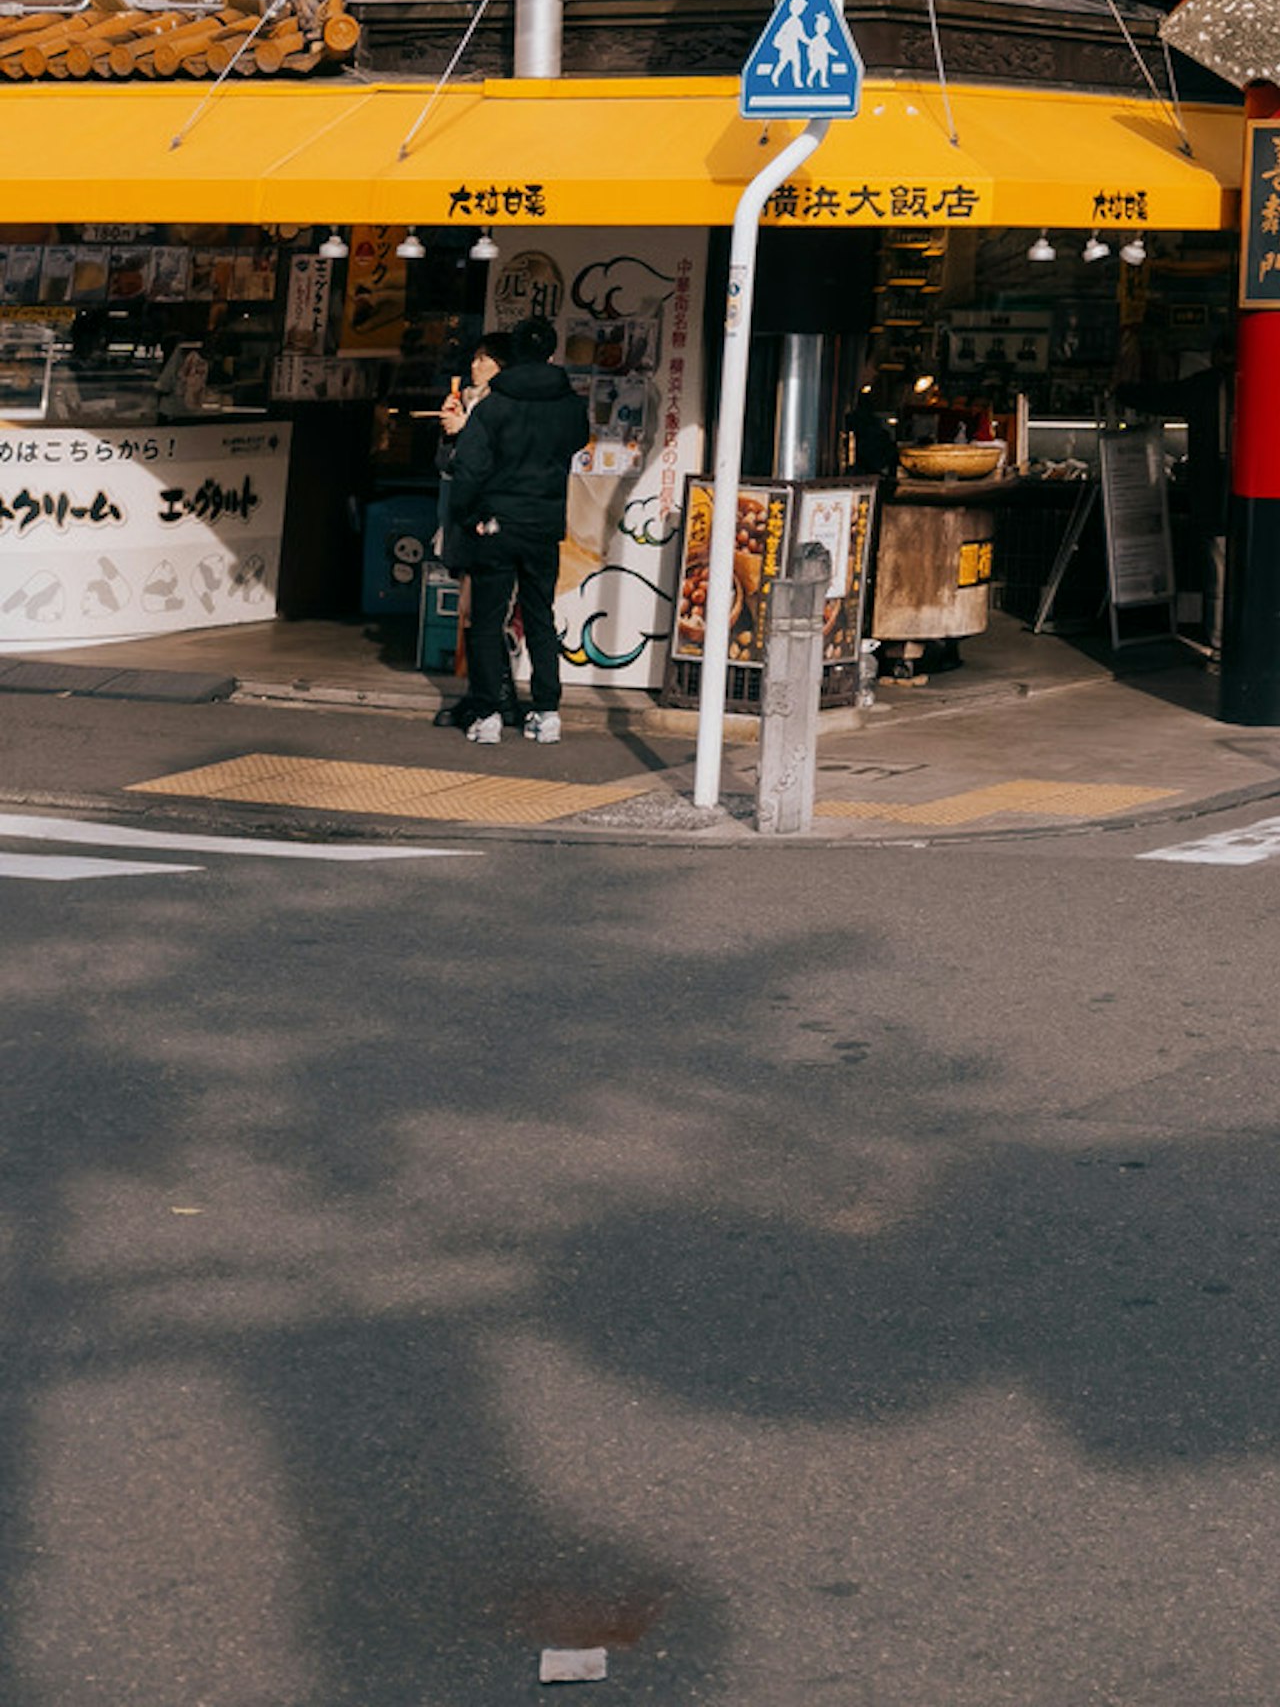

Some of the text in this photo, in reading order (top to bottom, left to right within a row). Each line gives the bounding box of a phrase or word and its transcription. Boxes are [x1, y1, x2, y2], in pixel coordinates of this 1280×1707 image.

[763, 184, 980, 220] 横浜大飯店
